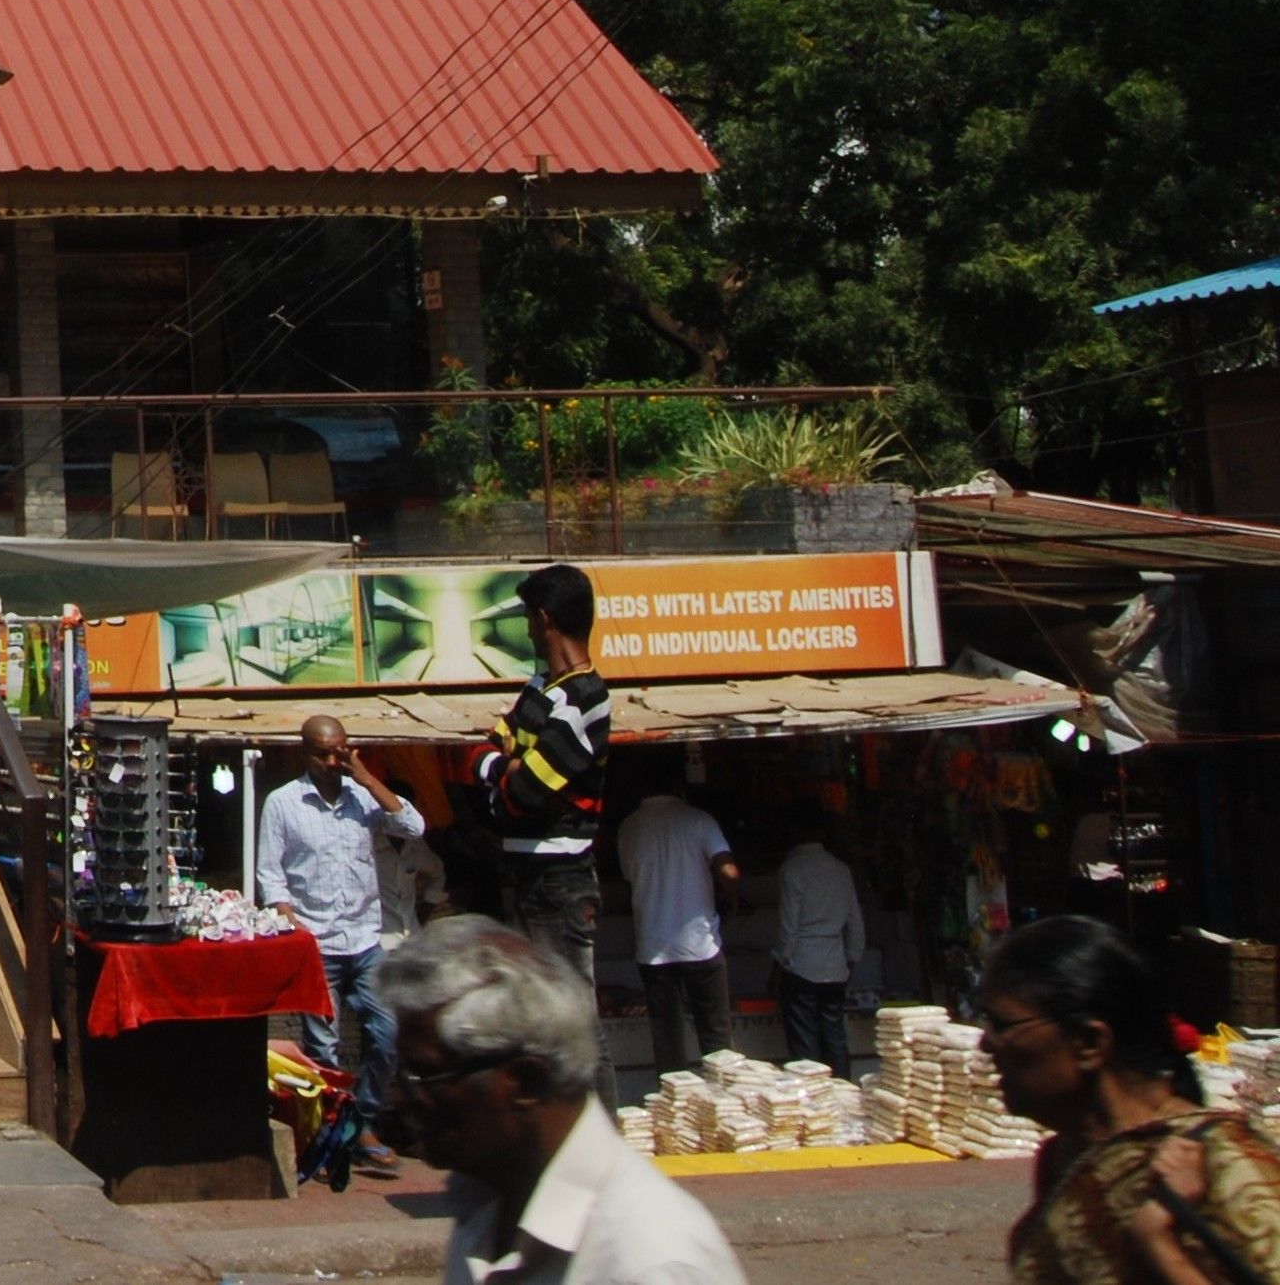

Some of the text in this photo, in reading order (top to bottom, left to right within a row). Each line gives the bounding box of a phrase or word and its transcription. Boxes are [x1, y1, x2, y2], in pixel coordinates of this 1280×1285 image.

[597, 585, 895, 619] BEDS WITH LATEST AMENITIES
[601, 625, 858, 657] AND INDIVIDUAL LOCKERS
